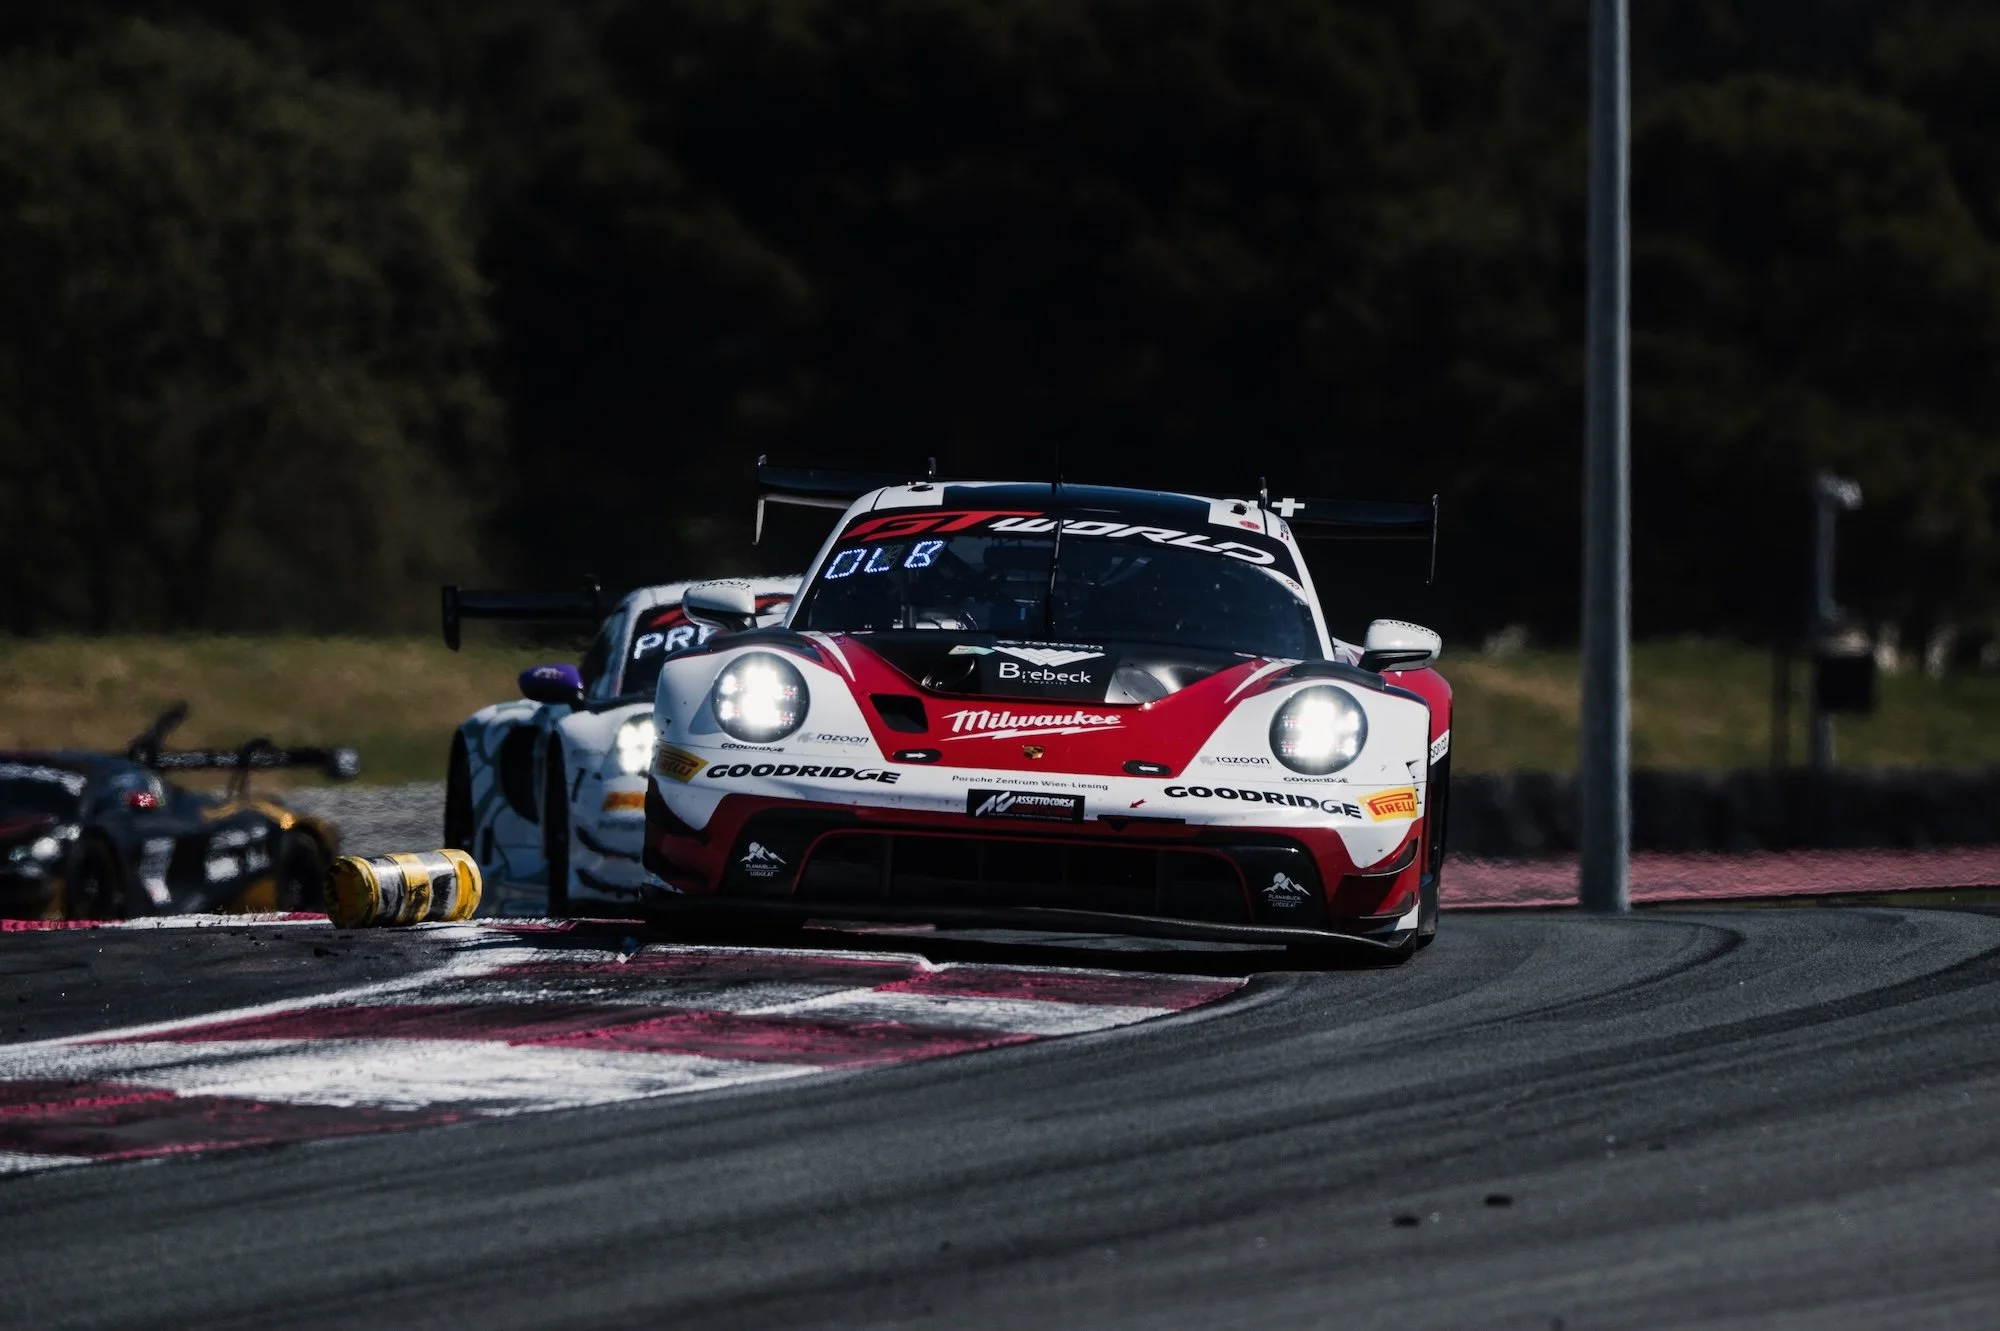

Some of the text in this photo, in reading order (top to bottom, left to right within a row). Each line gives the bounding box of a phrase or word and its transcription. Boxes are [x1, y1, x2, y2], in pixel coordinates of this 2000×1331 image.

[840, 510, 1276, 565] GT WORLD
[941, 709, 1122, 733] Milwaukee
[816, 733, 869, 744] razoon
[1215, 756, 1270, 765] razoon
[706, 764, 901, 784] GOODRIDGE
[952, 775, 993, 783] Porsche
[995, 777, 1039, 786] Zentrum
[1016, 795, 1075, 808] ASSETTO CORSA
[1163, 786, 1362, 819] GOODRIDGE
[1367, 792, 1415, 816] PIRELLI
